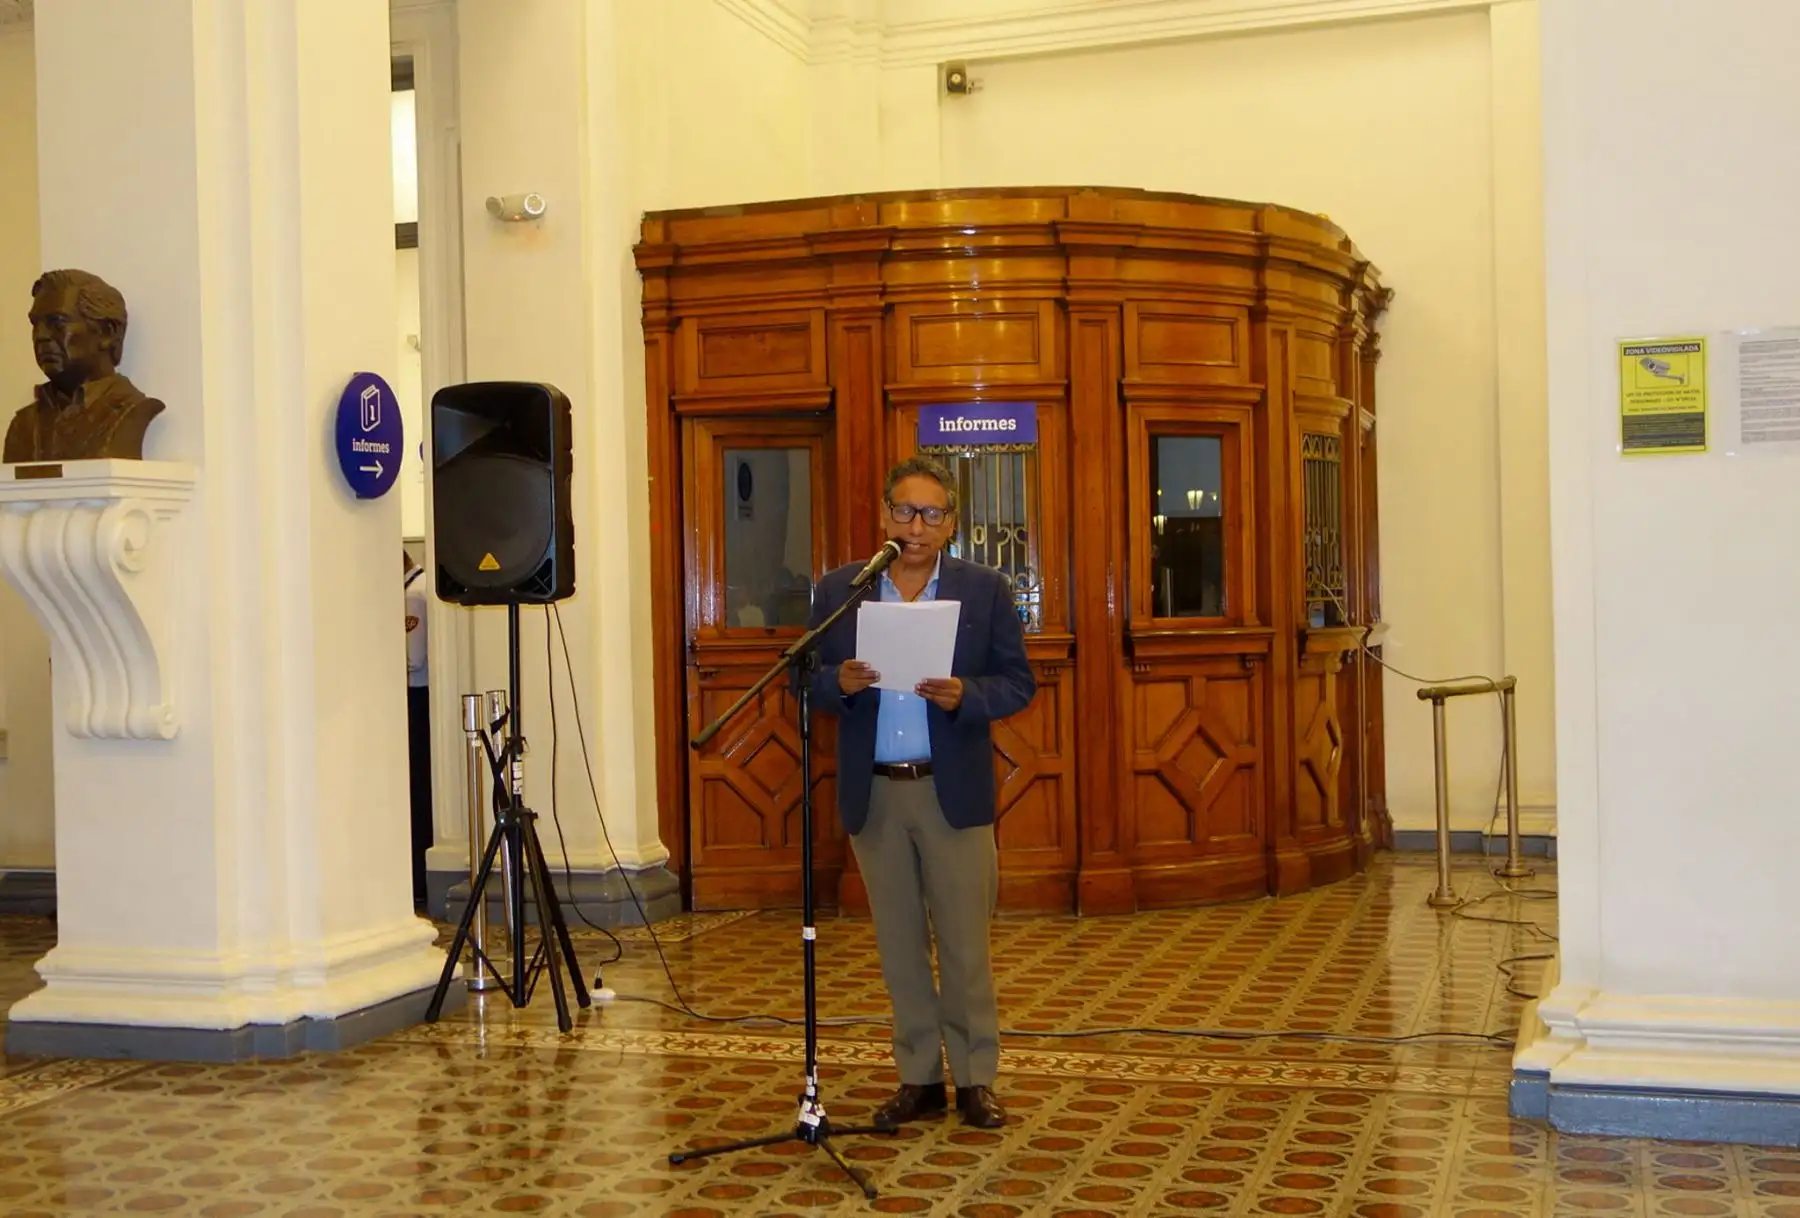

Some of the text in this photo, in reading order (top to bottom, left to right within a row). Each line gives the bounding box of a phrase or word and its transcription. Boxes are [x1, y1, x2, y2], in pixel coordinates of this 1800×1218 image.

[1625, 347, 1645, 355] ZONA
[939, 416, 1017, 432] informes
[352, 438, 390, 453] informes
